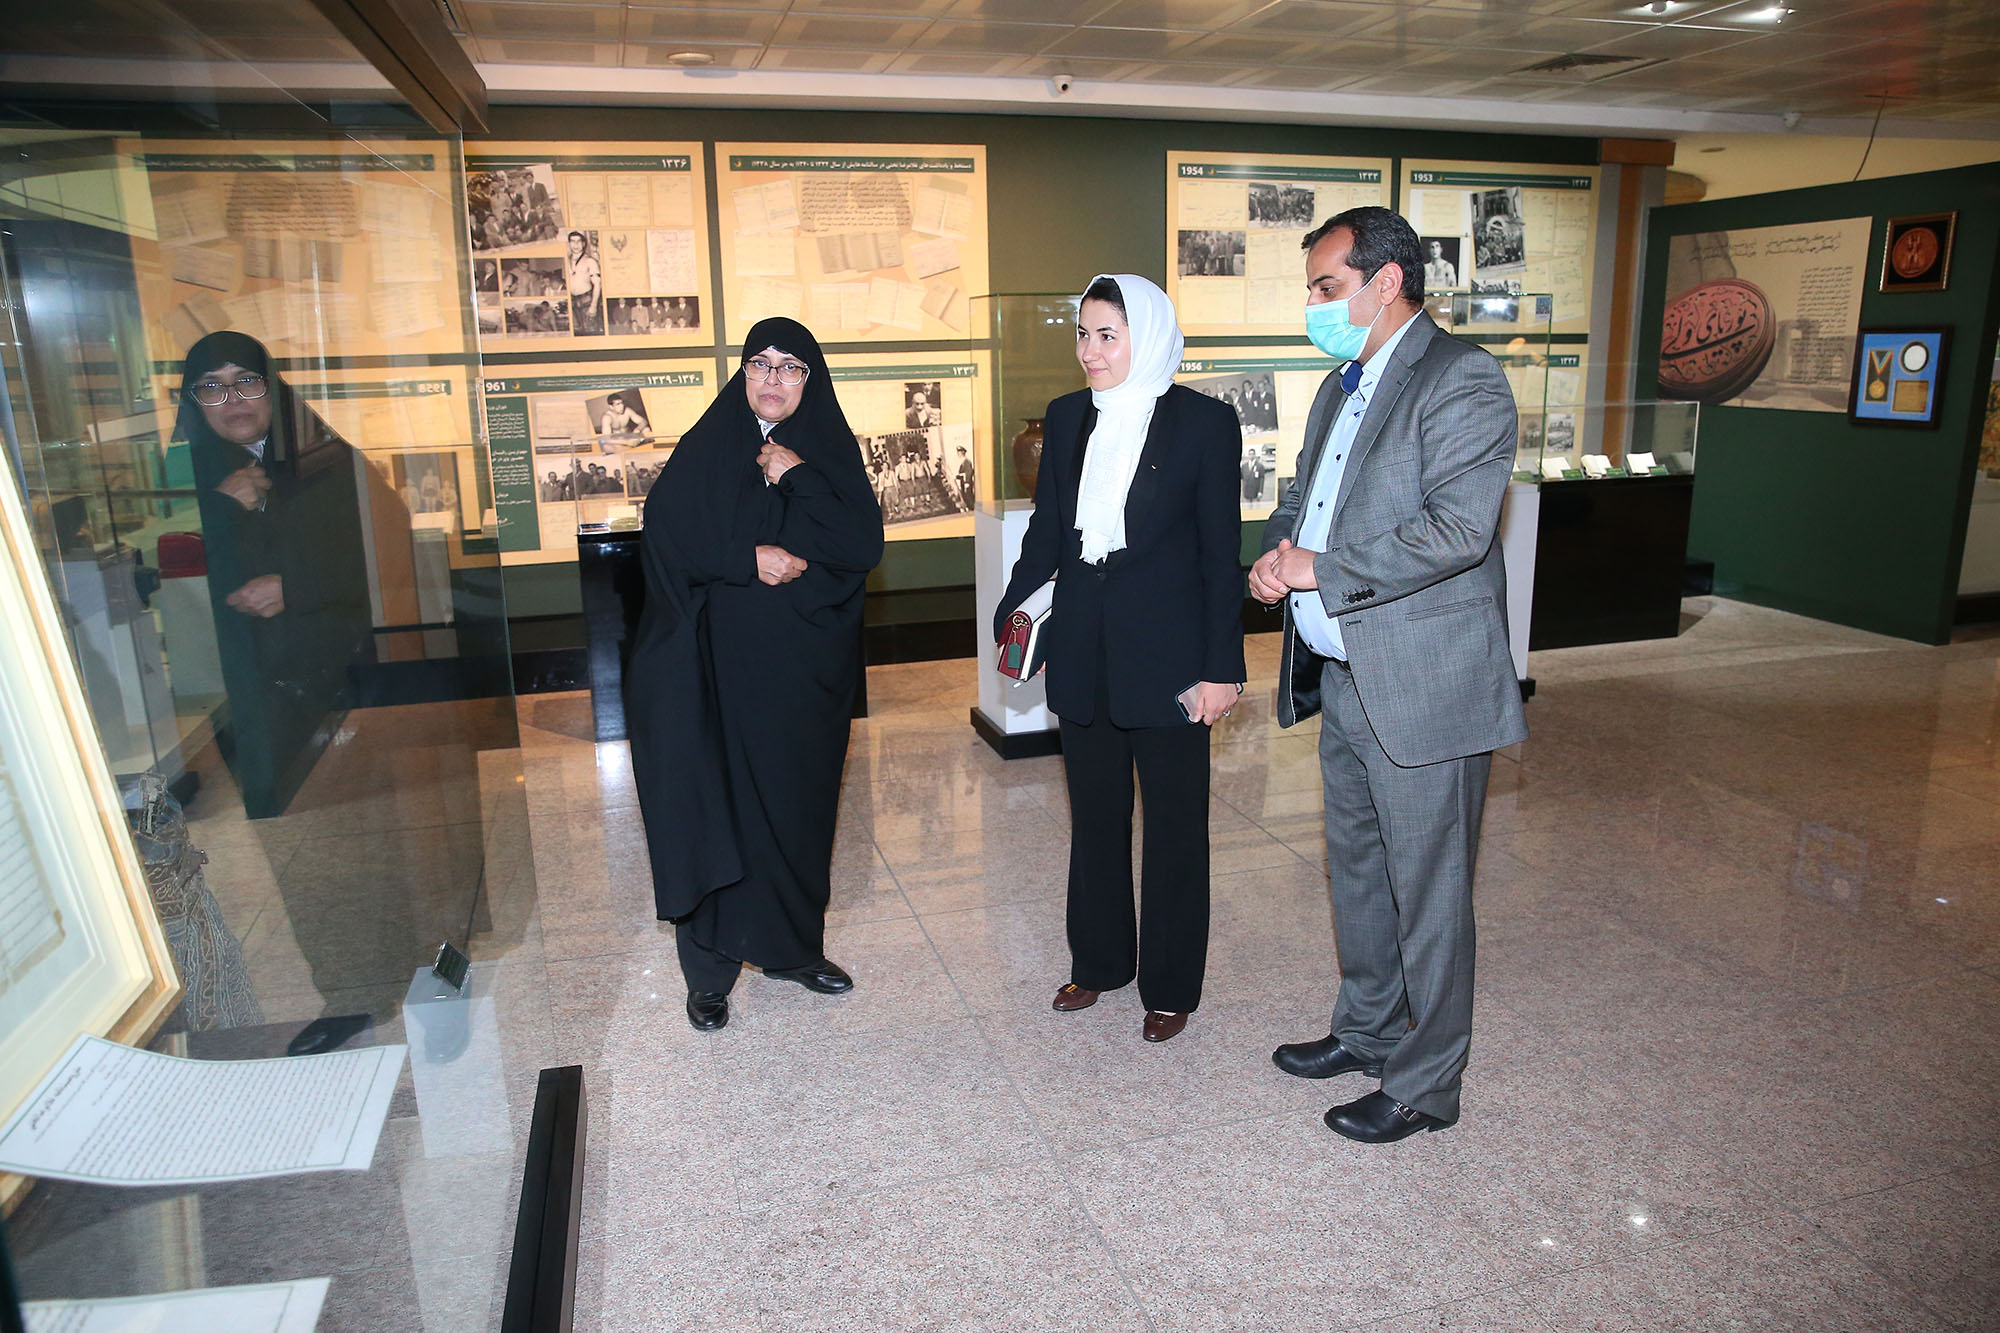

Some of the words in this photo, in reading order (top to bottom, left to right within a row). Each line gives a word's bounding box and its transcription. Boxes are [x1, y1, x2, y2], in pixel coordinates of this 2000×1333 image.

[662, 159, 687, 168] ۱۳۳۶
[1181, 166, 1204, 176] 1954
[1413, 173, 1433, 182] 1953
[1180, 362, 1202, 371] 1956
[485, 381, 506, 392] 961
